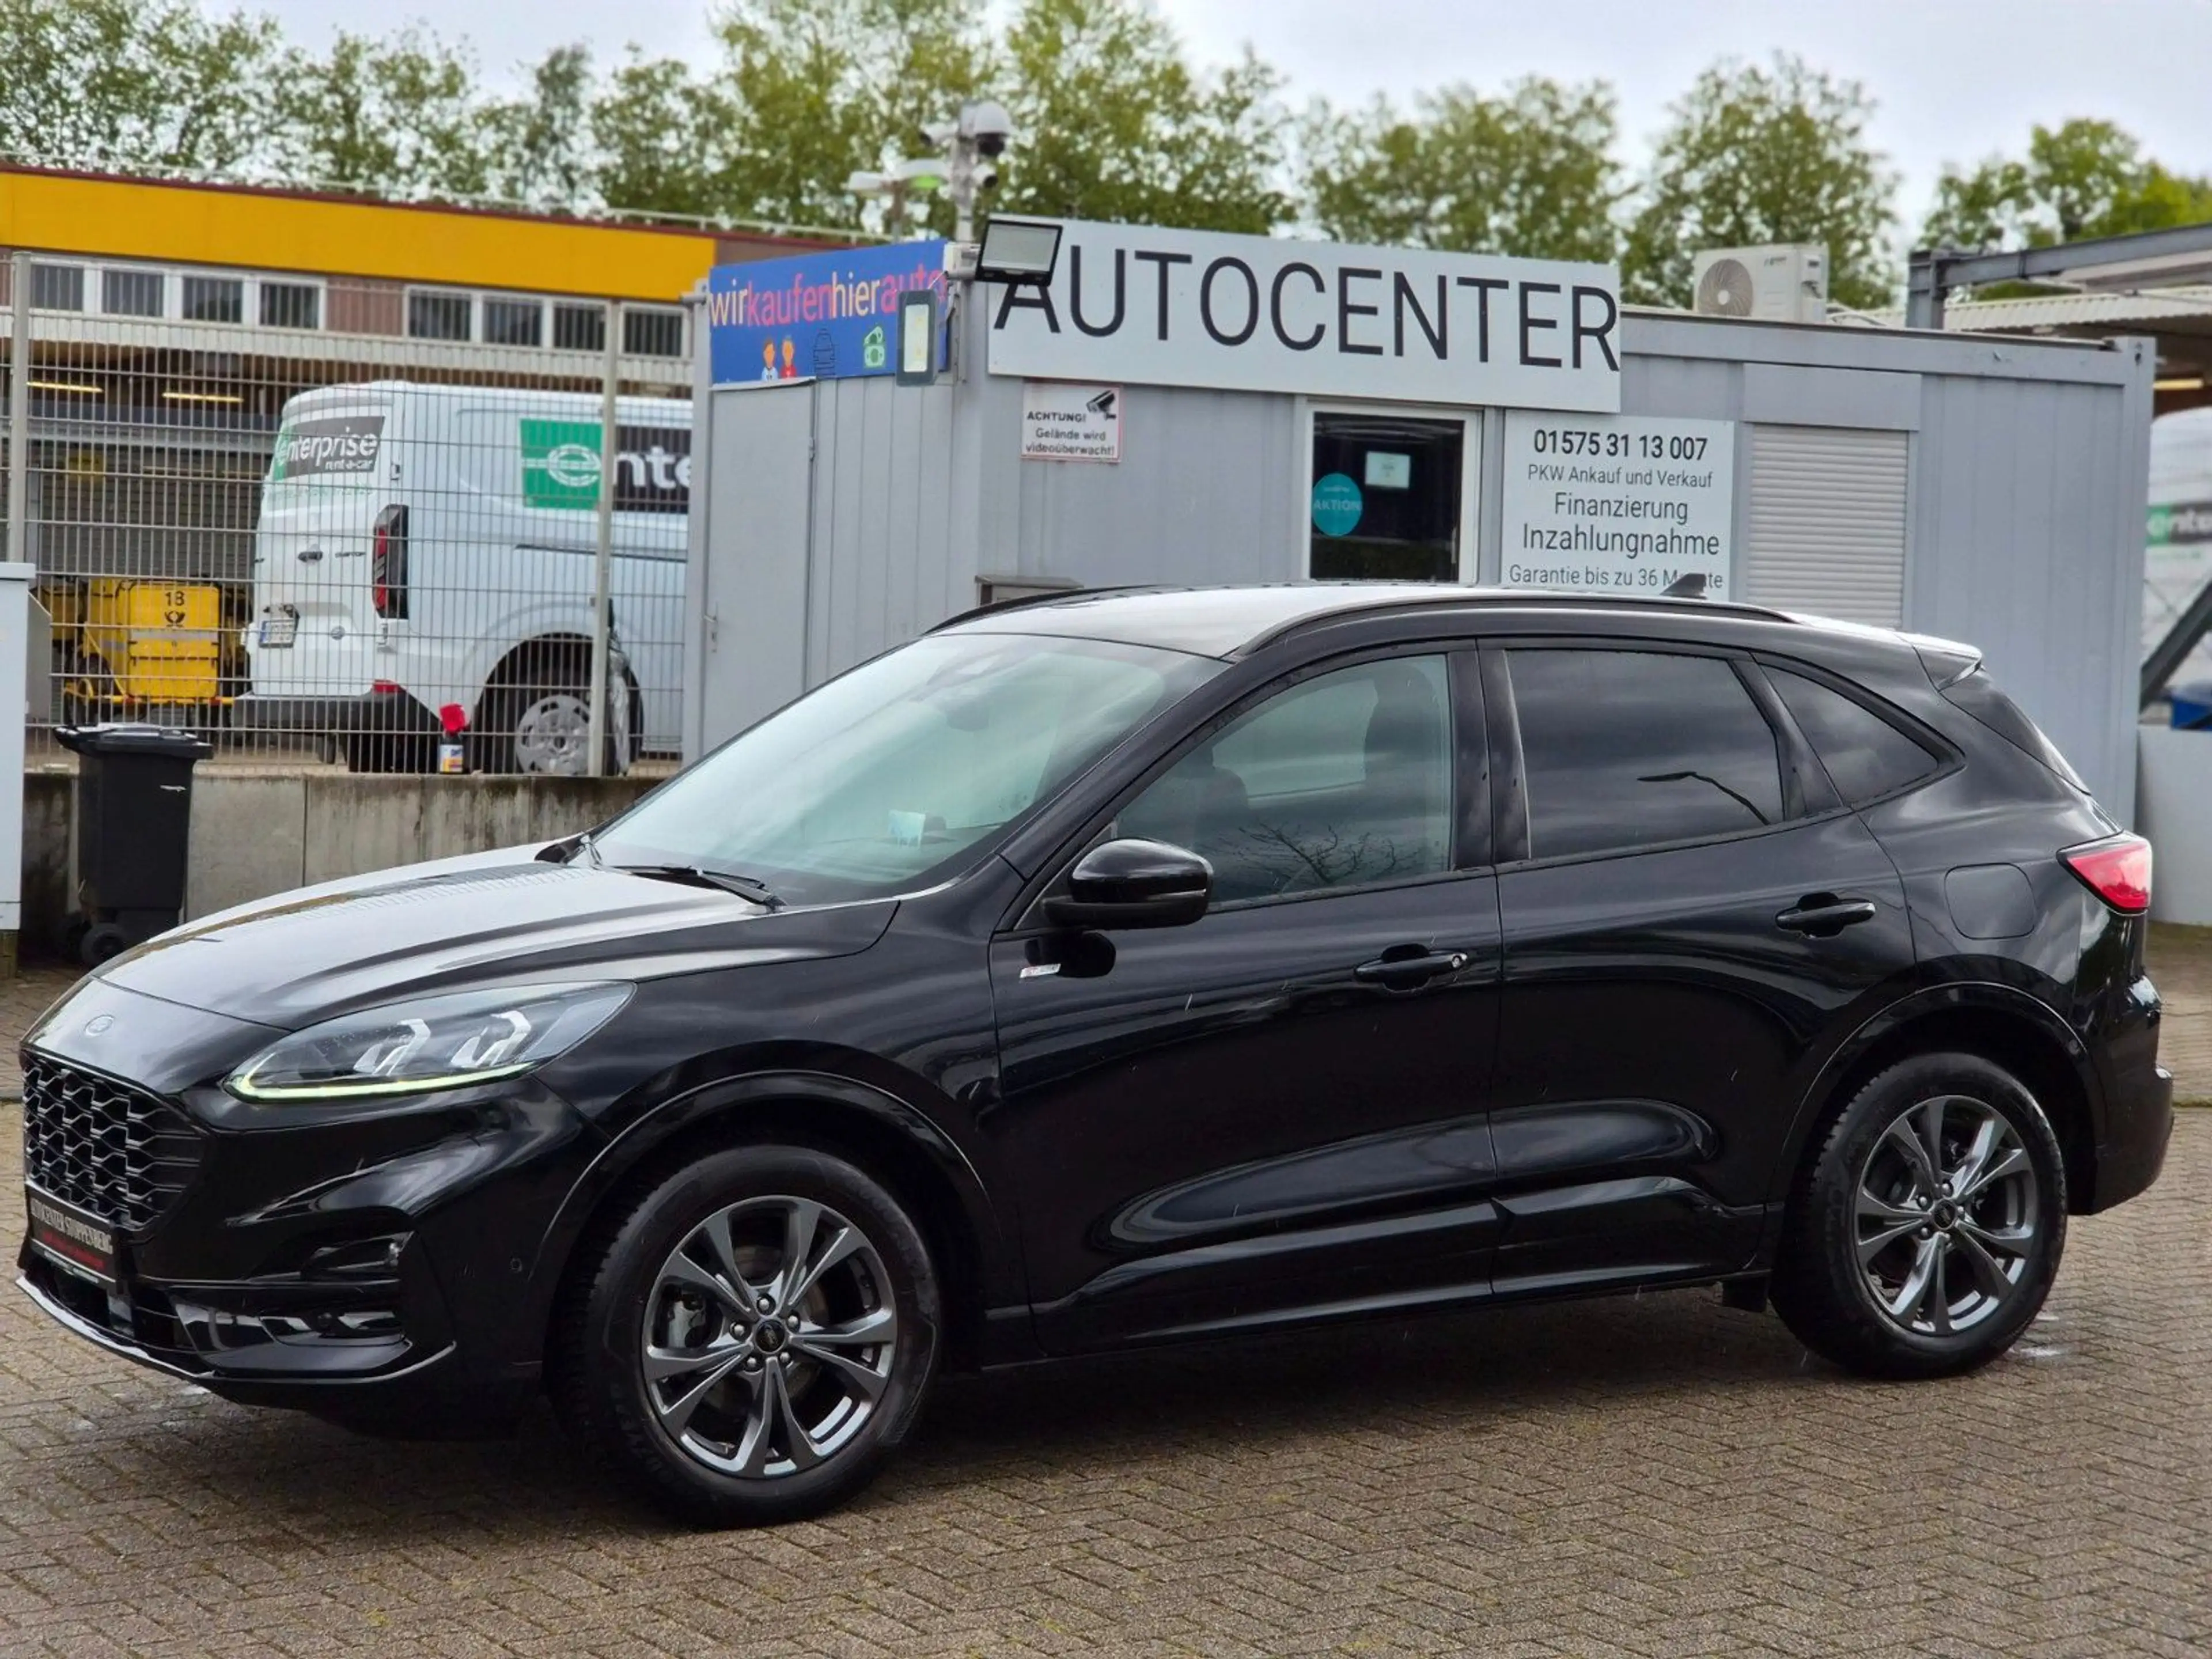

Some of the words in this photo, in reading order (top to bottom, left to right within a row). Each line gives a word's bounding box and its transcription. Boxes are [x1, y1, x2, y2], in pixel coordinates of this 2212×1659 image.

[994, 244, 1619, 372] AUTOCENTER
[1027, 411, 1086, 423] ACHTUNG!
[278, 426, 379, 468] enterprise
[1035, 428, 1080, 440] Gelände
[1083, 431, 1107, 441] wird
[1534, 429, 1601, 456] 01575
[1606, 433, 1630, 457] 31
[1639, 435, 1663, 459] 13
[1669, 436, 1708, 461] 007
[1025, 442, 1114, 456] videoüberwacht!
[1528, 464, 1565, 482] PKW
[1568, 465, 1622, 485] Ankauf
[1626, 469, 1652, 486] und
[1657, 470, 1713, 488] Verkauf
[1555, 491, 1688, 525] Finanzierung
[1522, 522, 1719, 559] Inzahlungnahme
[1509, 564, 1580, 584] Garantie
[1585, 566, 1609, 586] bis
[1613, 572, 1633, 586] zu
[1638, 568, 1658, 587] 36
[1662, 569, 1723, 589] Mte
